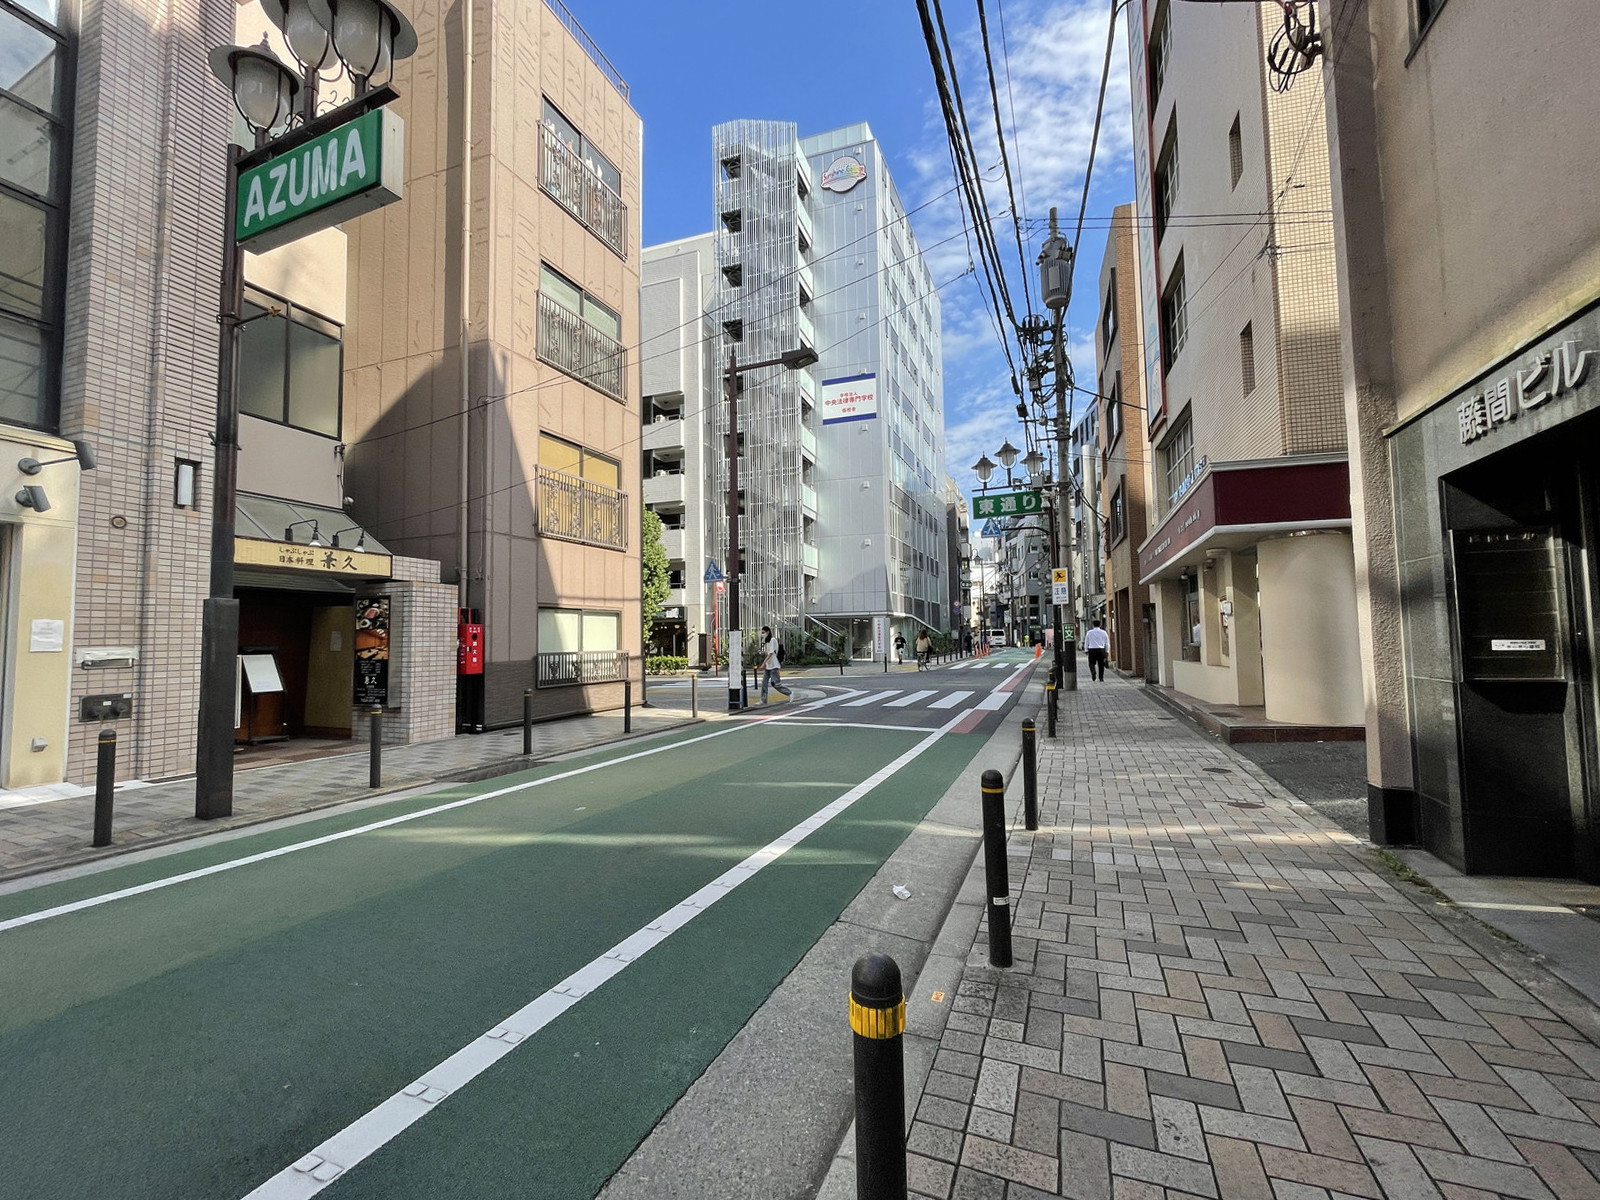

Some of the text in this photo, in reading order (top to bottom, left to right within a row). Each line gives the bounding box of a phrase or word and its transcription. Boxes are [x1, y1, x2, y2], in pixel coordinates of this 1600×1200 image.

[243, 128, 366, 227] AZUMA
[825, 393, 874, 406] 中央法律専門学校
[1456, 340, 1588, 443] 藤間ビル
[978, 494, 1036, 515] 東通り
[279, 546, 315, 555] しゃぶしゃぶ
[279, 555, 315, 566] 日本料理
